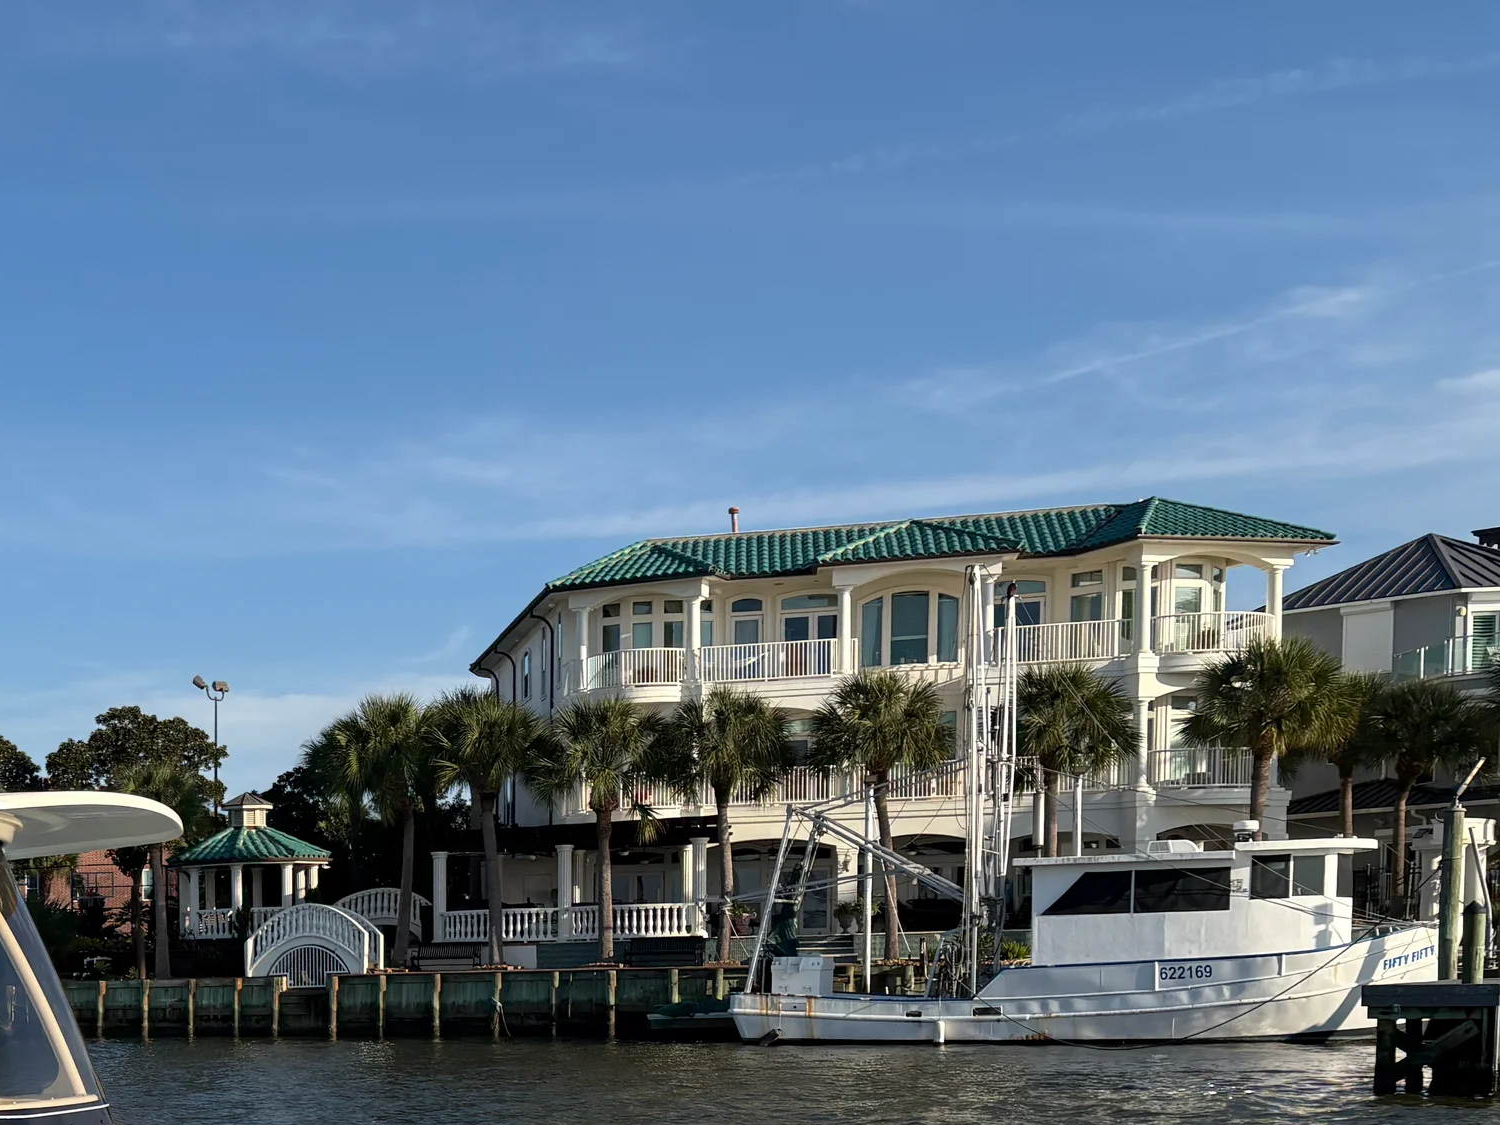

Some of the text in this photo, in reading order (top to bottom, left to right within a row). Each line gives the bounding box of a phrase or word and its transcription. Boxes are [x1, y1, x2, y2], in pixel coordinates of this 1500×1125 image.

[1383, 945, 1435, 970] FIFTY FIFTY
[1160, 965, 1212, 980] 622169
